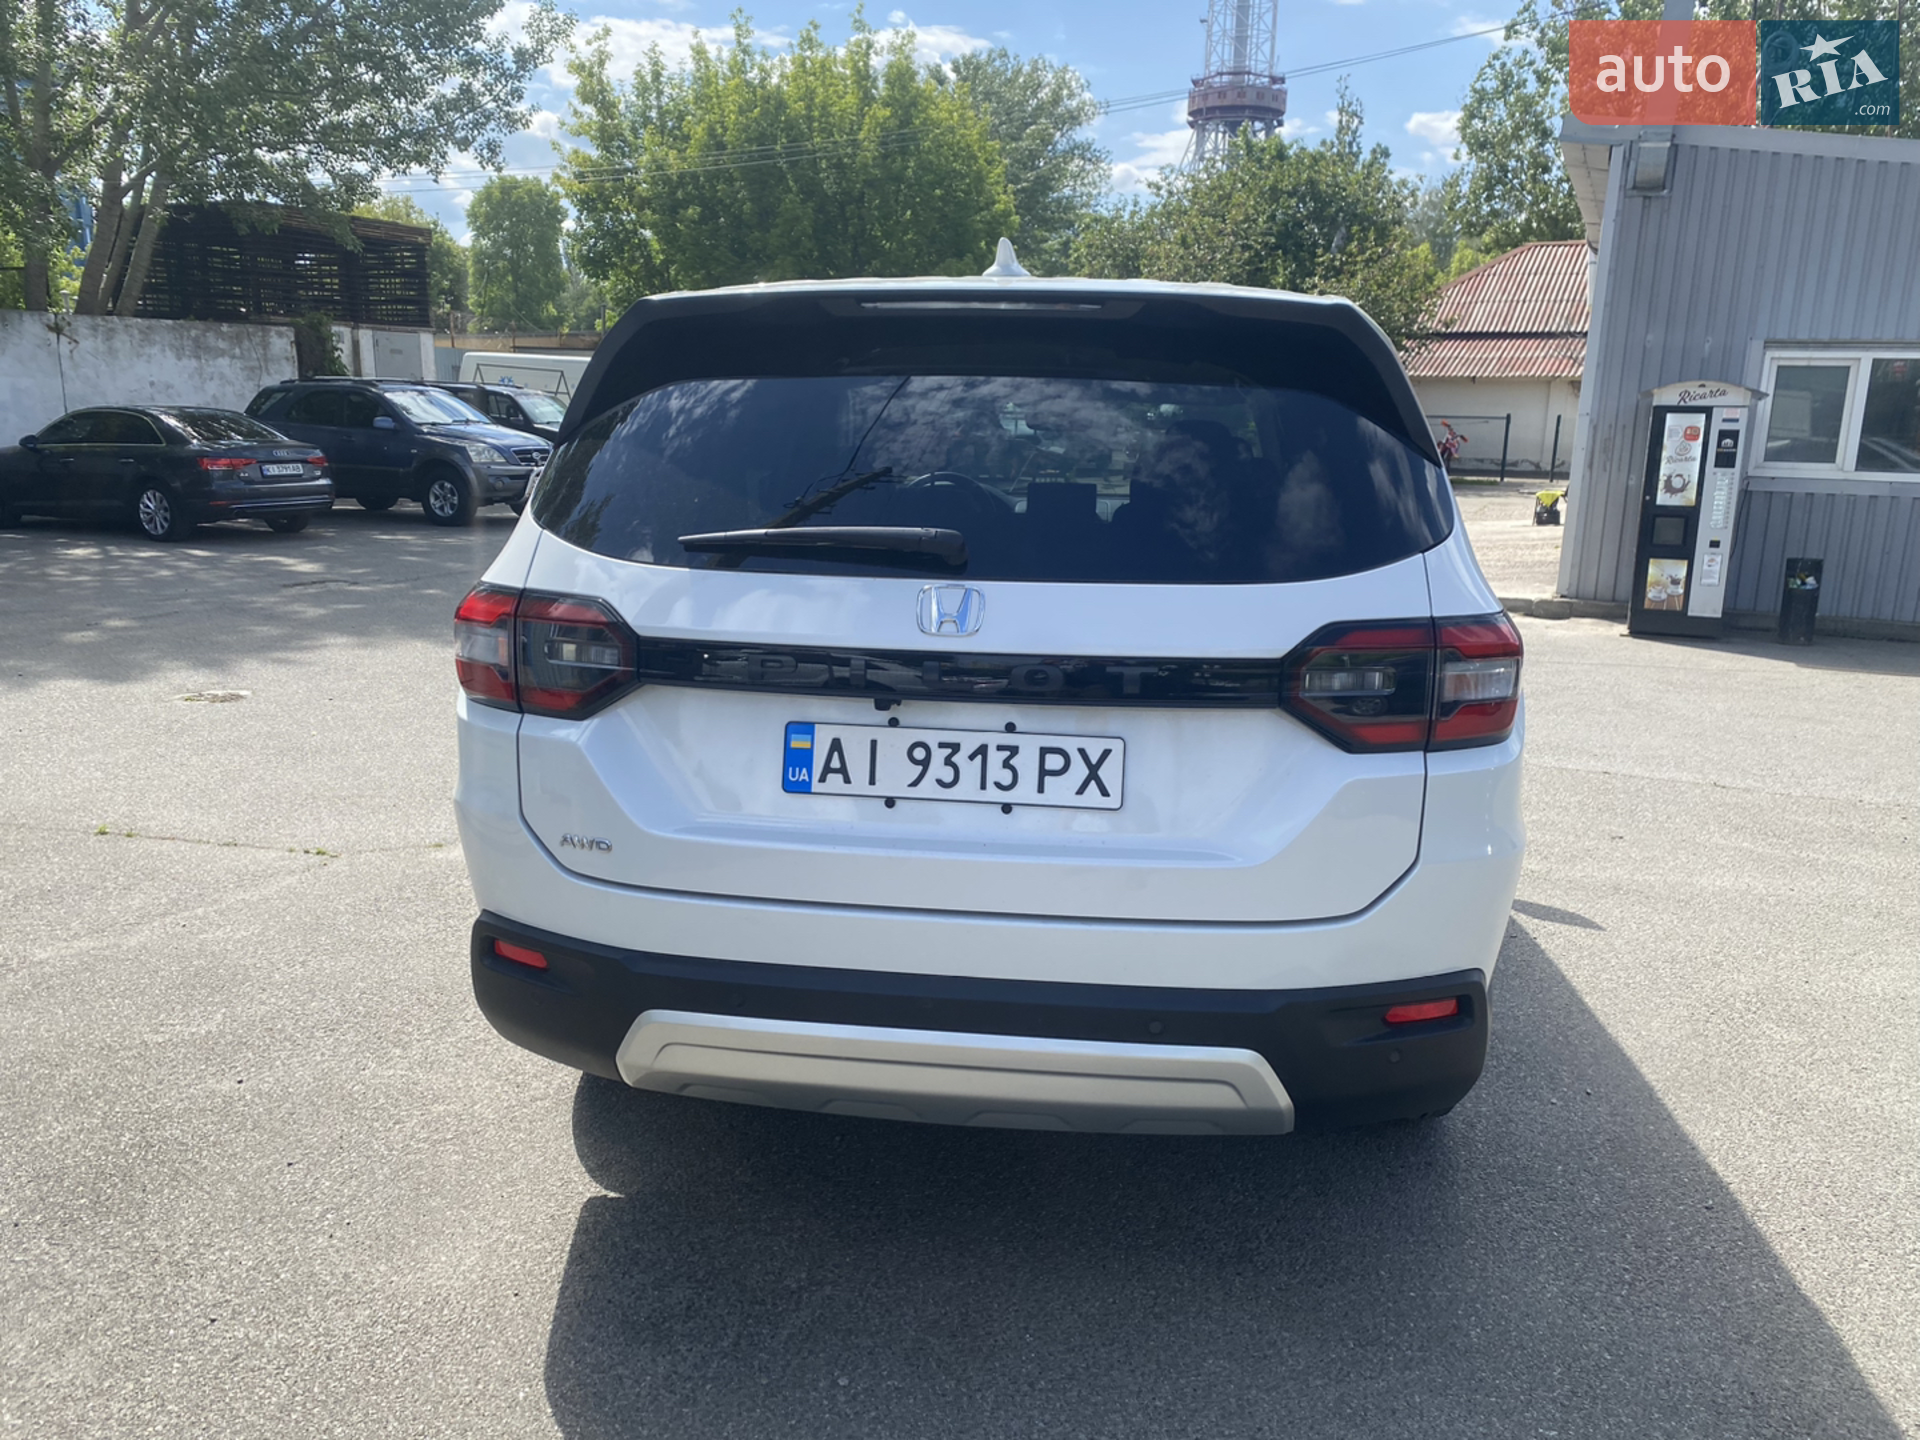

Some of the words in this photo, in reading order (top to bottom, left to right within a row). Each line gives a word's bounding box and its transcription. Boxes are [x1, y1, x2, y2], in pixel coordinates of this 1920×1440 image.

[748, 653, 1159, 695] PILOT
[788, 767, 810, 782] UA
[817, 737, 878, 786] AI
[906, 741, 1020, 792] 9313
[1037, 746, 1113, 798] PX
[560, 833, 613, 853] AWD
